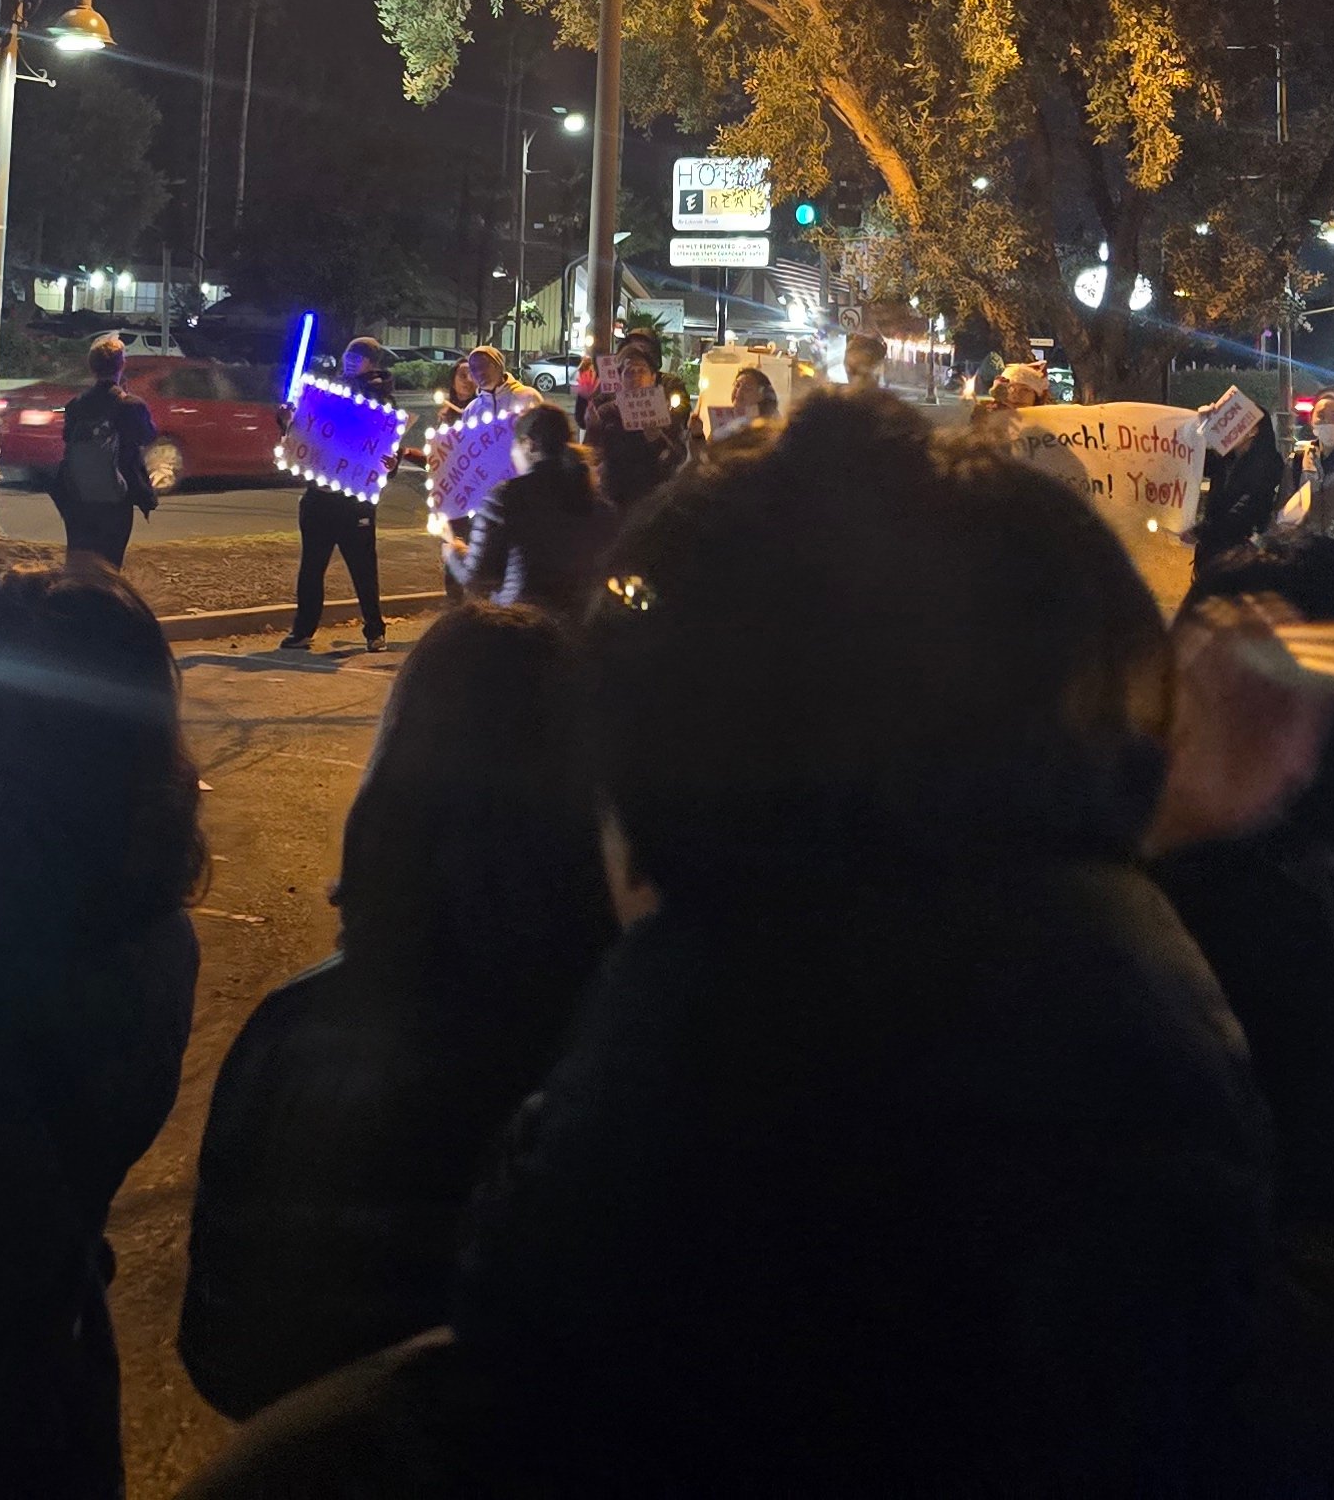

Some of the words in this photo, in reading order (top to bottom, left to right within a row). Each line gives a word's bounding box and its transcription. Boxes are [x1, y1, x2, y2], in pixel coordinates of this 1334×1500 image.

[678, 163, 766, 188] HOT
[306, 412, 380, 456] YON
[428, 428, 466, 471] SAVE
[1118, 424, 1195, 465] Dictator
[431, 413, 517, 510] DEMOCRAC
[454, 466, 488, 511] SAVE
